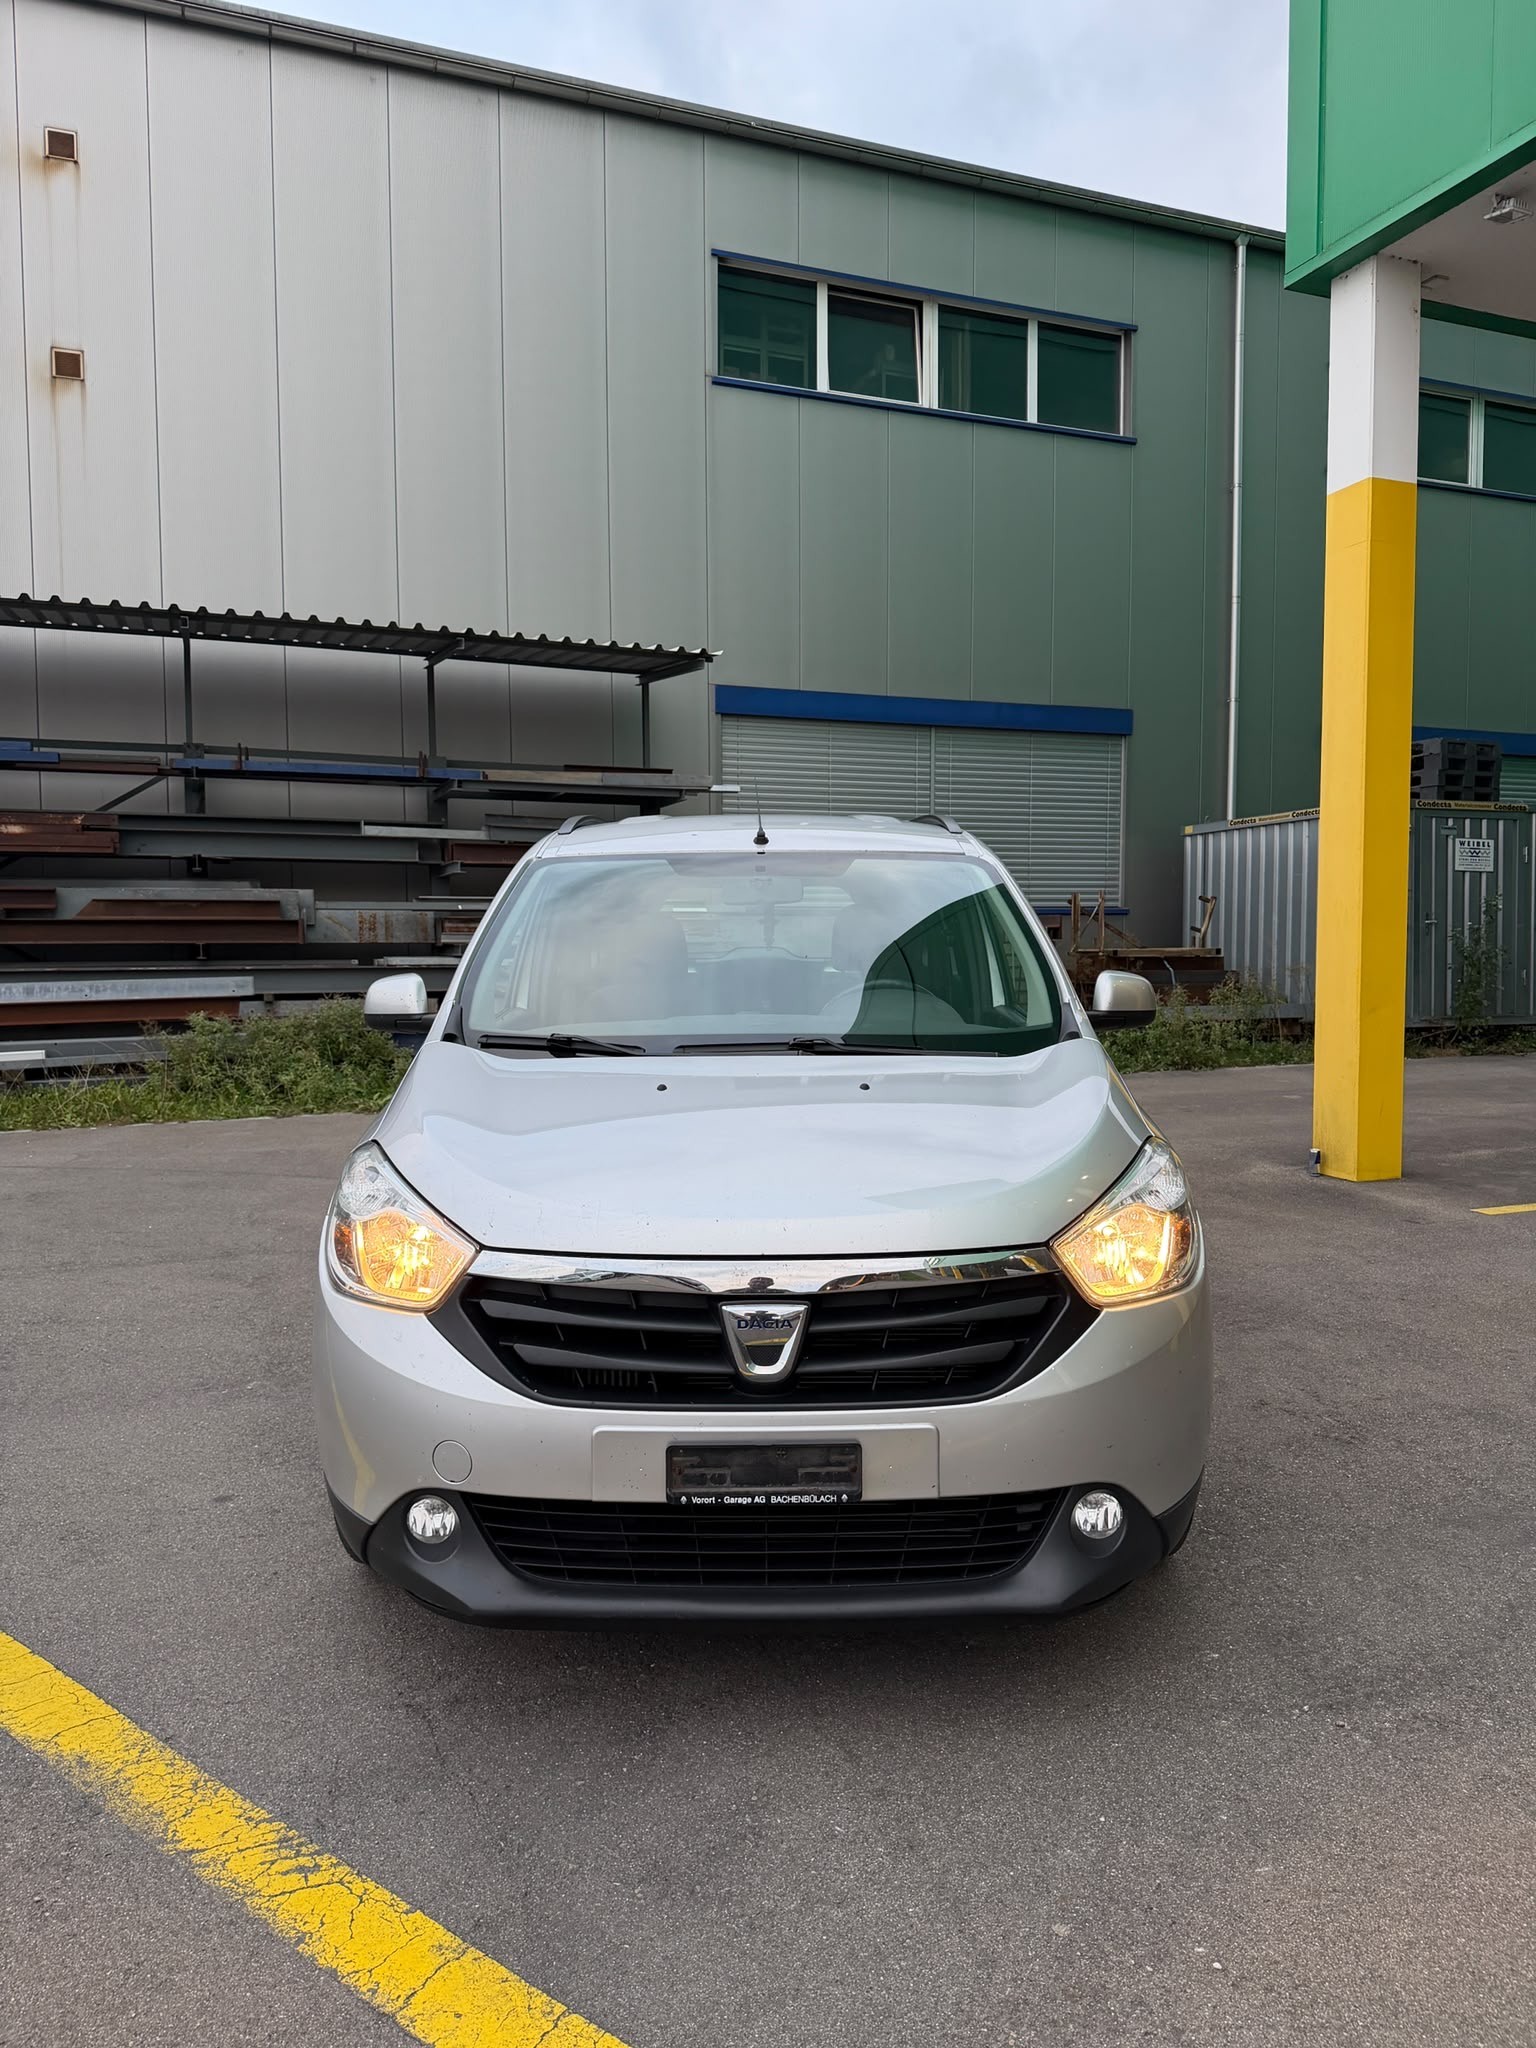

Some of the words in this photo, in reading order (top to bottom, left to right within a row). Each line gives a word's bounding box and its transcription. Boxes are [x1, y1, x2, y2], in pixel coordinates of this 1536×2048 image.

[1417, 800, 1452, 808] Condecta
[1493, 803, 1527, 811] Condecta
[1229, 818, 1257, 826] Condecta
[1459, 840, 1491, 848] WEIBEL
[737, 1319, 793, 1329] DACIA
[691, 1496, 716, 1504] Vorort
[723, 1495, 753, 1505] Garage
[753, 1495, 766, 1504] AG
